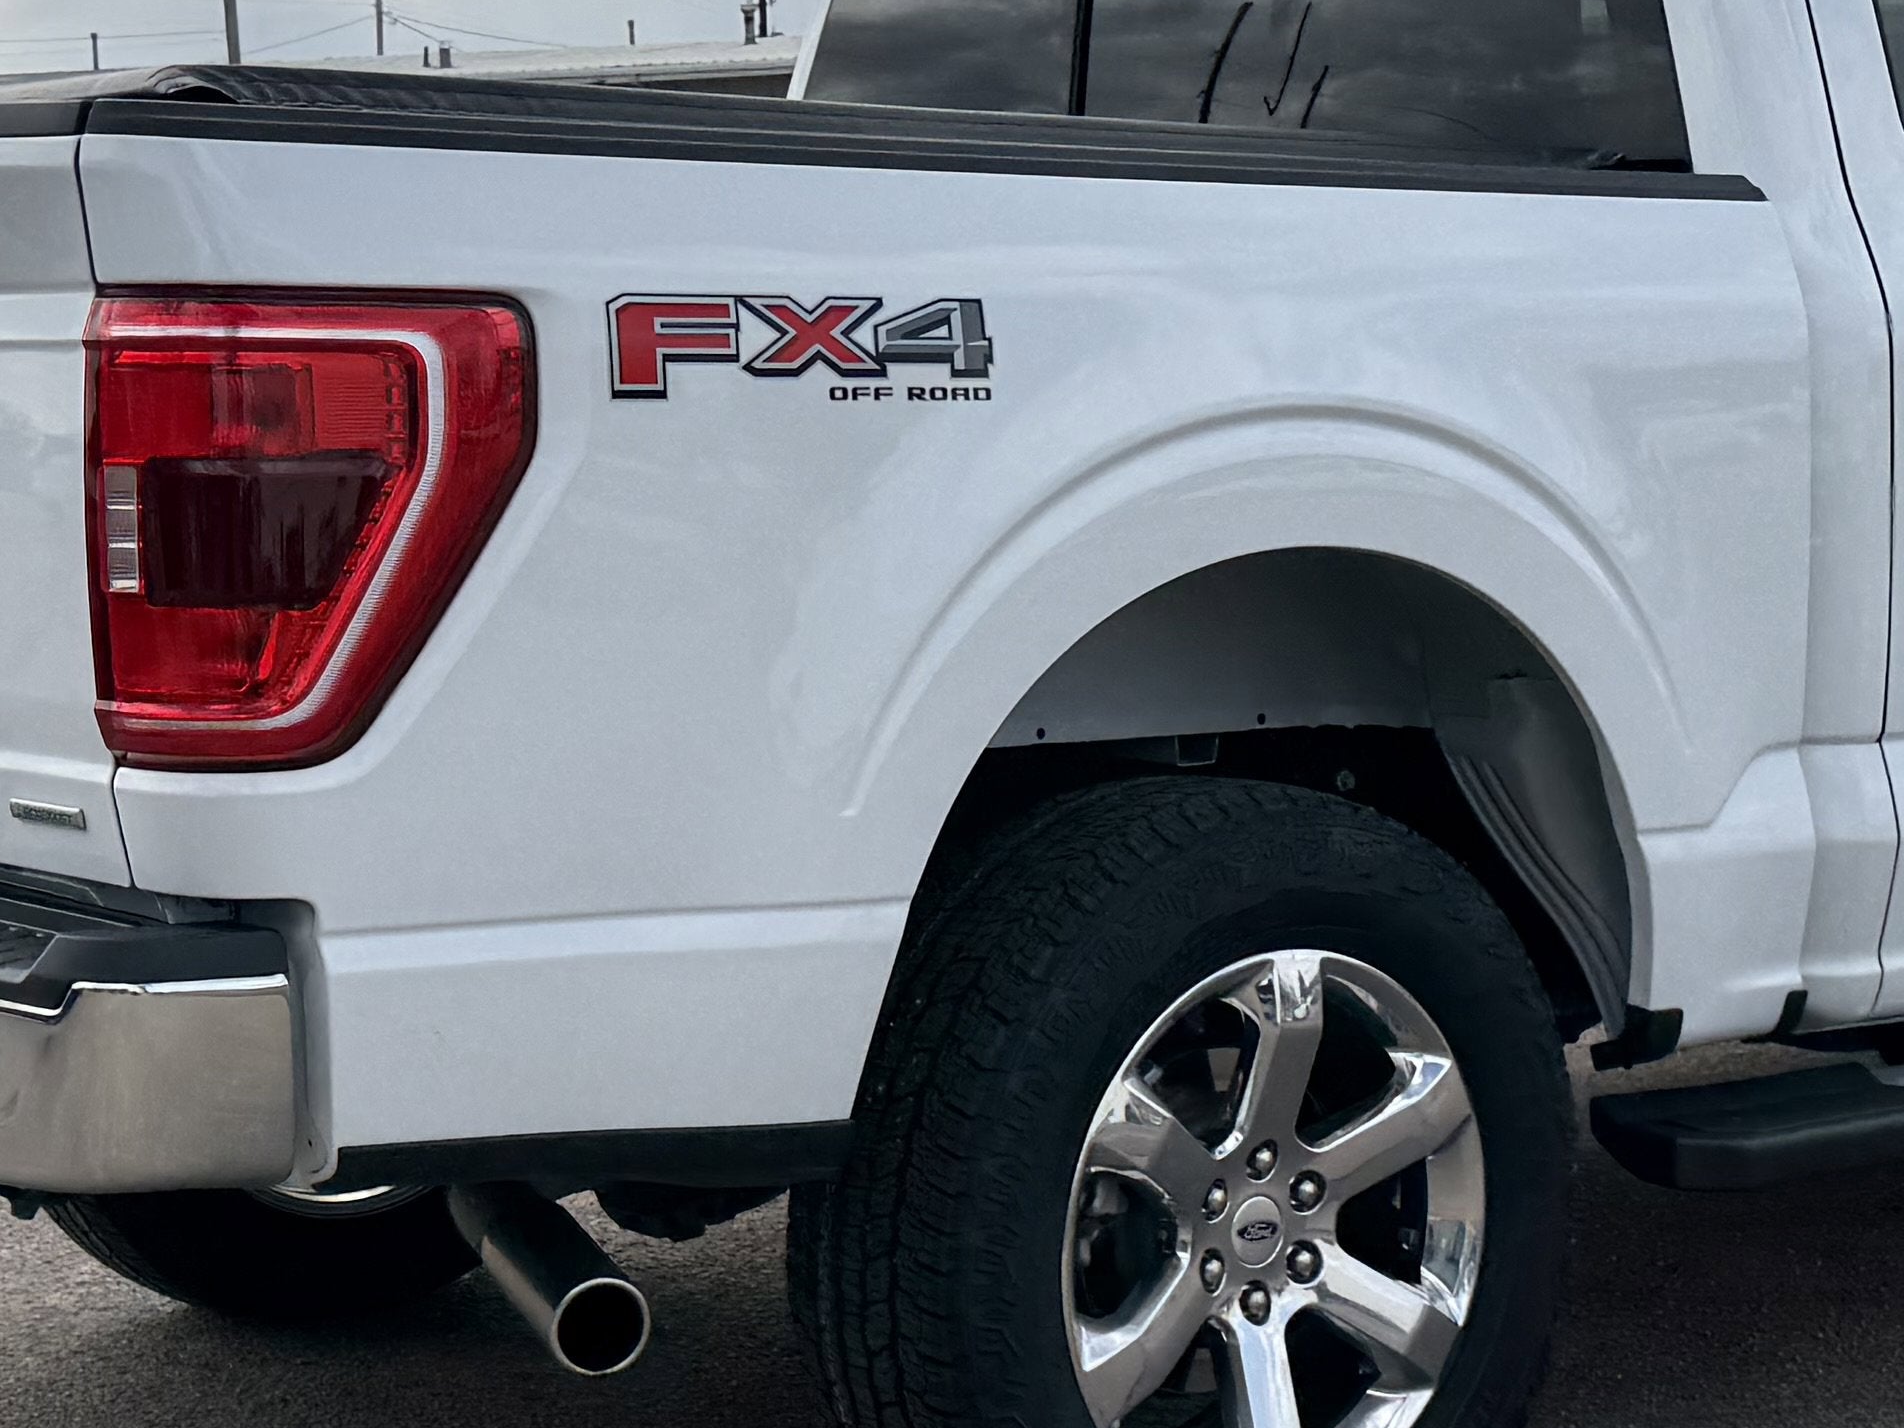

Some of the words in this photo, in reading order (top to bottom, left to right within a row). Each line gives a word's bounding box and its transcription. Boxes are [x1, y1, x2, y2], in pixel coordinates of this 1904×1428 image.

[606, 293, 994, 400] FX4
[829, 386, 894, 402] OFF
[907, 386, 993, 402] ROAD
